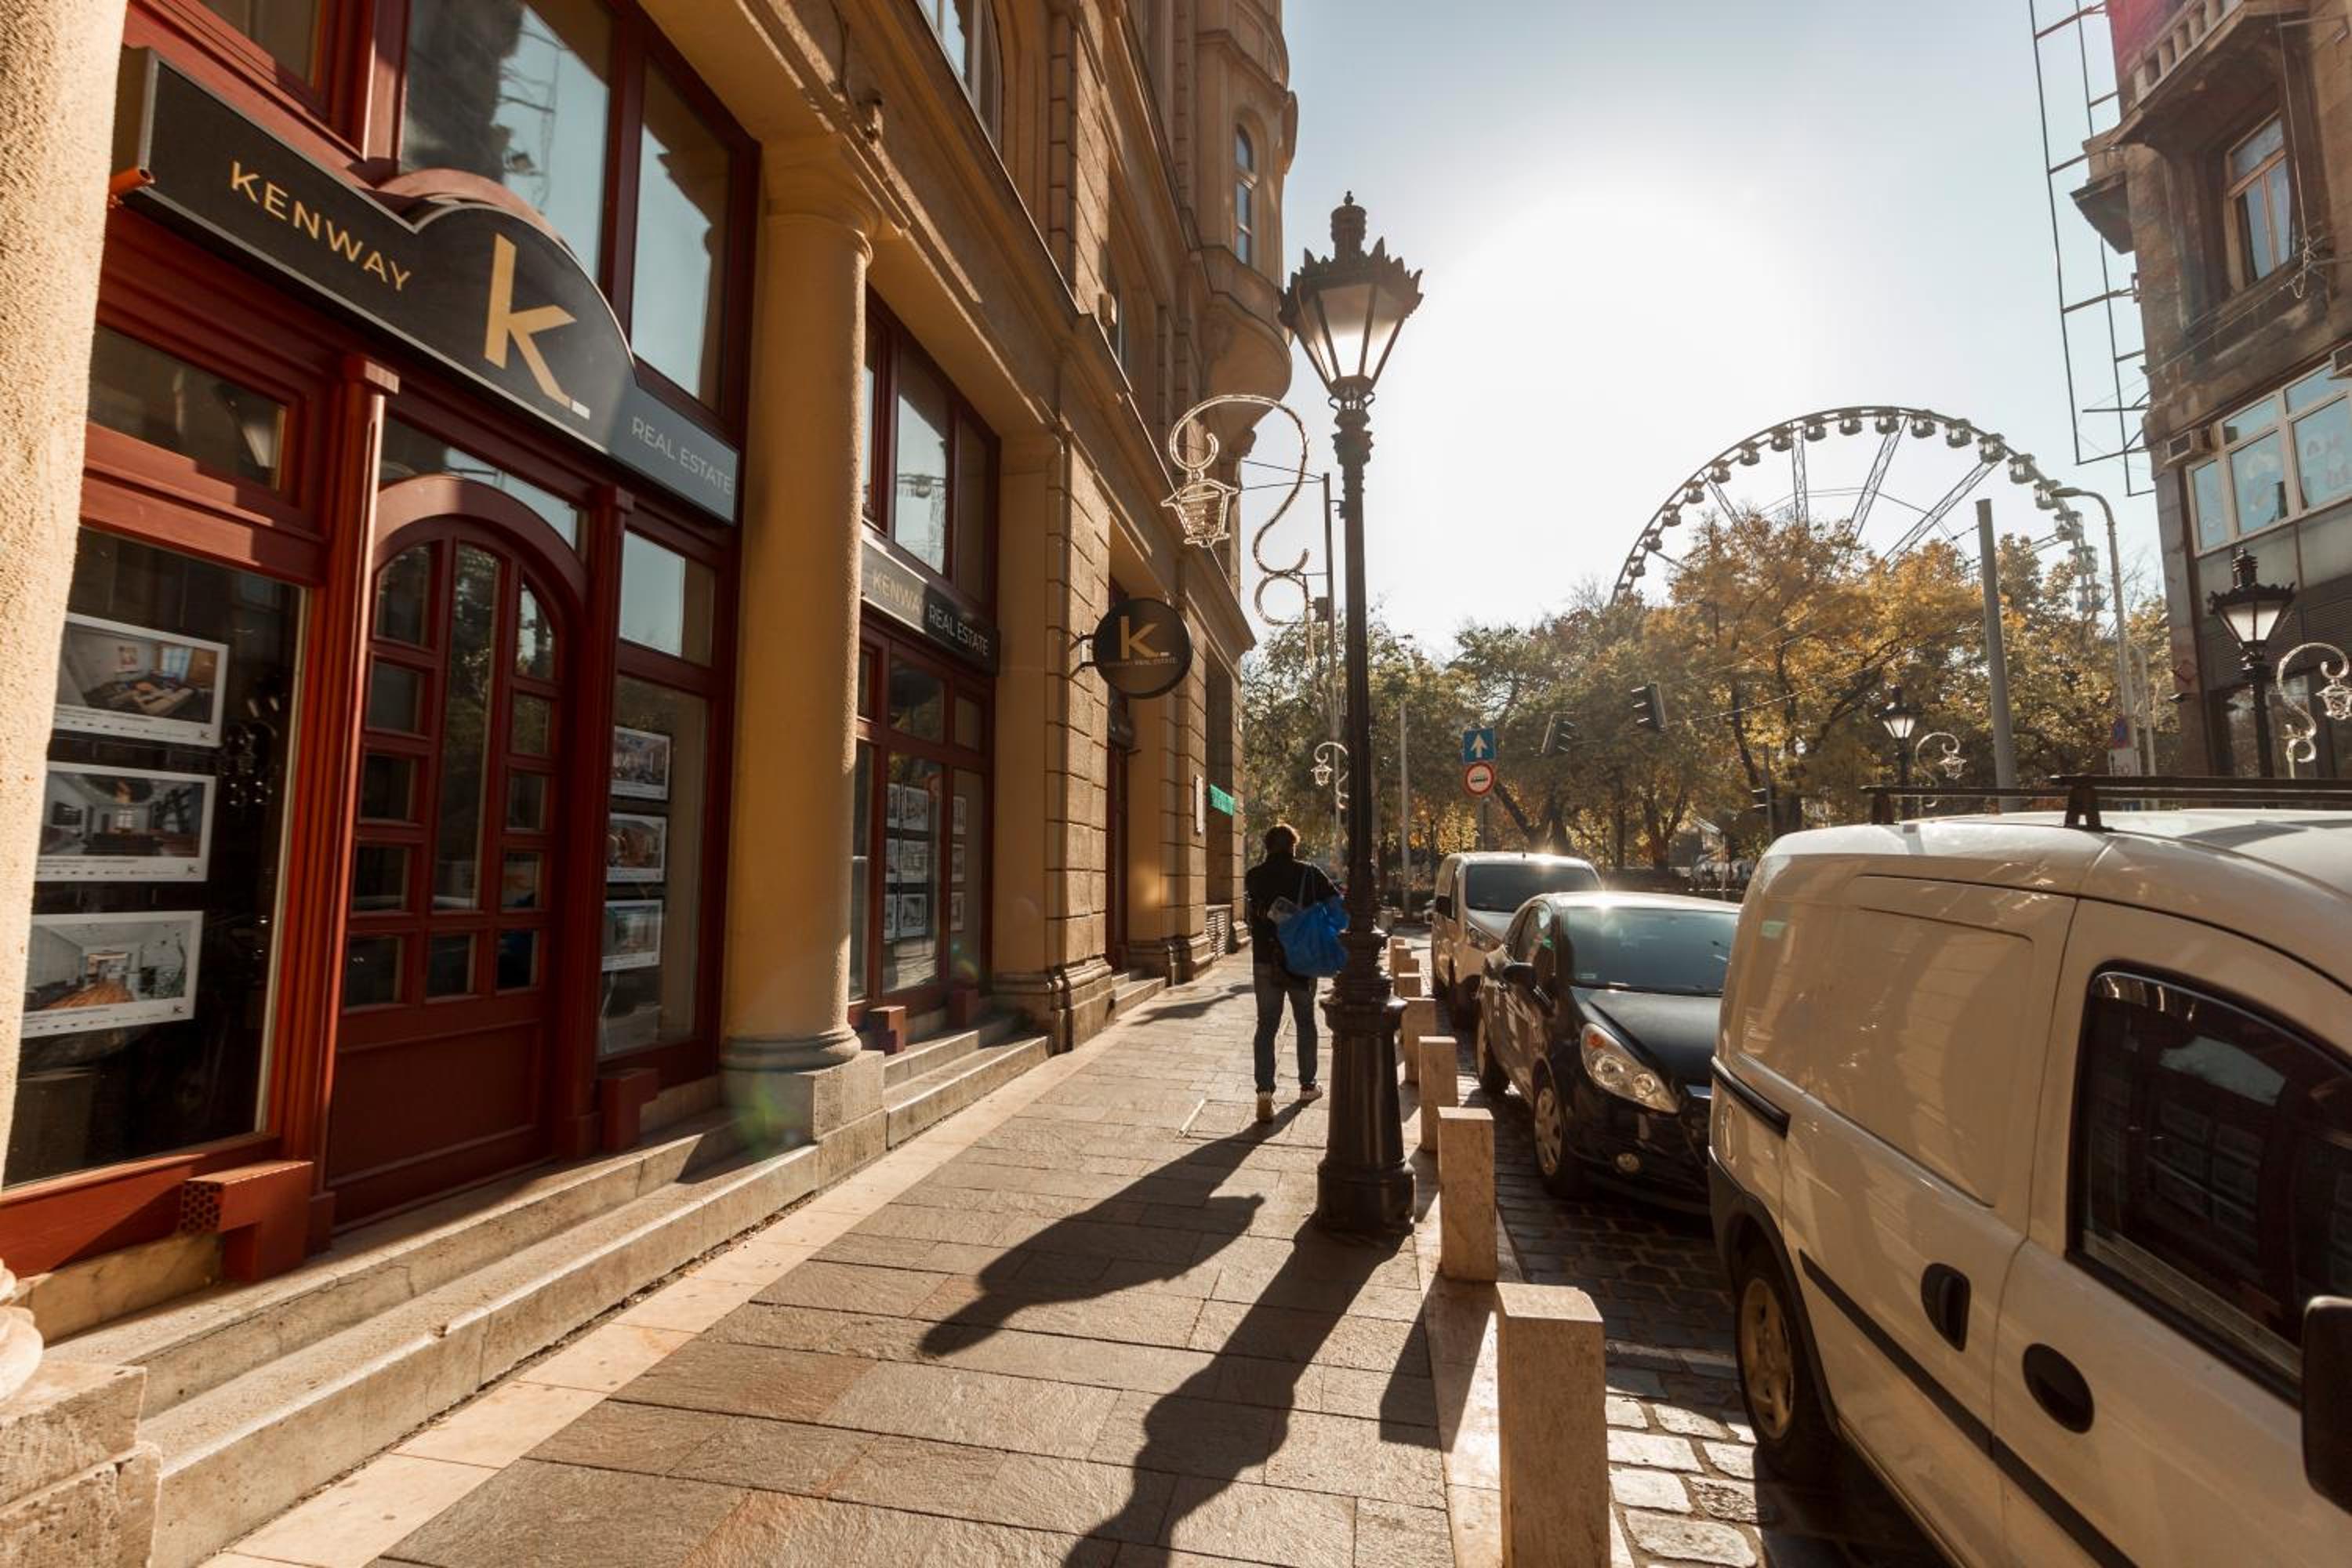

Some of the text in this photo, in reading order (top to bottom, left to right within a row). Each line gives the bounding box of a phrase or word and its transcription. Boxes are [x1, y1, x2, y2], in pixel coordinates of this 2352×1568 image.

[231, 161, 411, 291] KENWAY
[632, 416, 734, 495] REAL ESTATE
[928, 603, 956, 637] REAL
[957, 620, 989, 656] ESTATE
